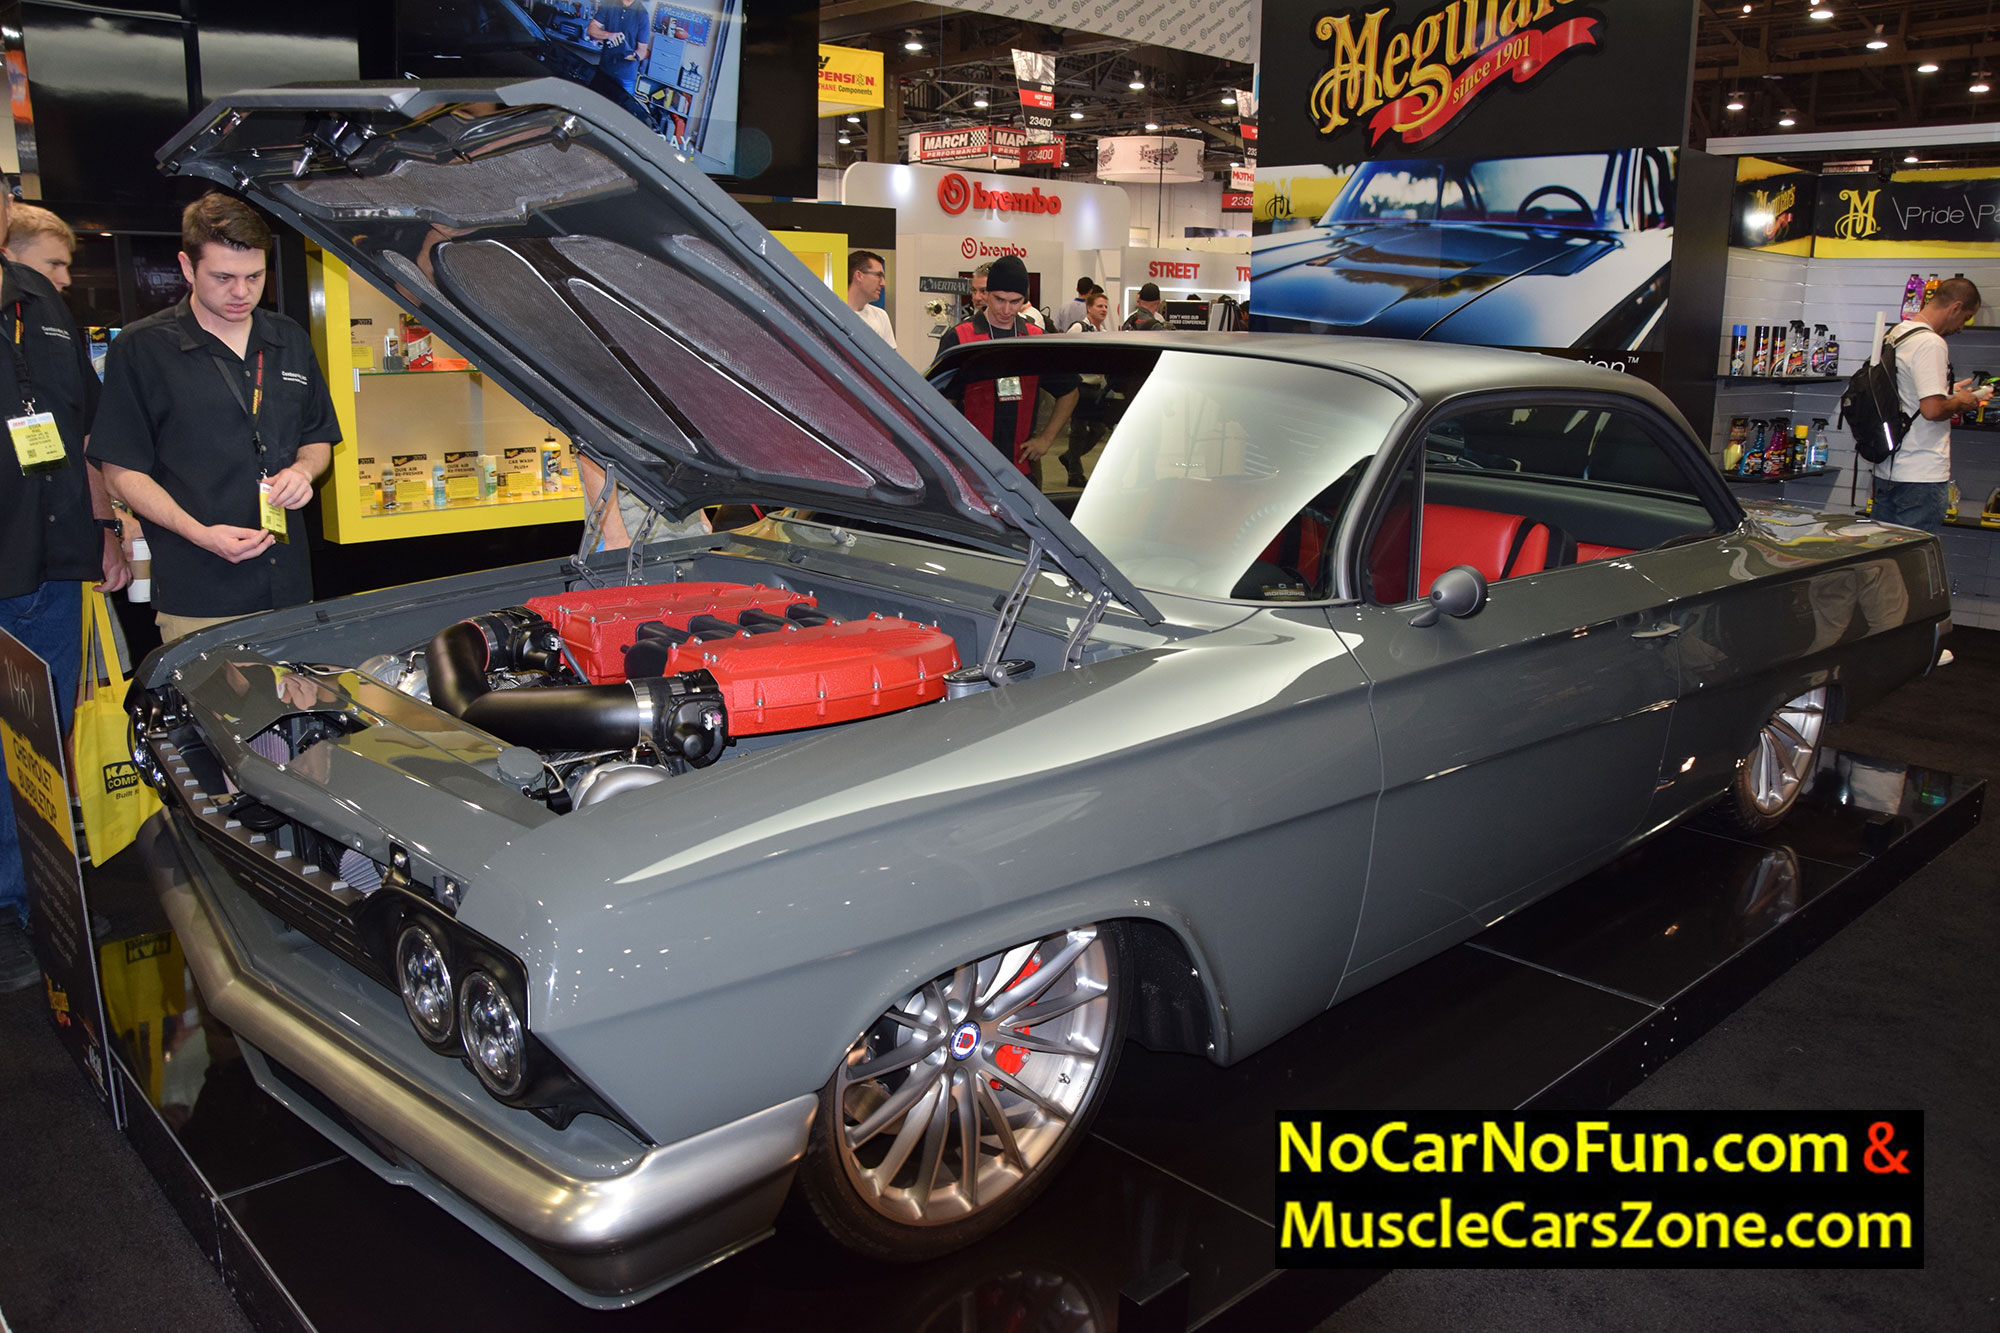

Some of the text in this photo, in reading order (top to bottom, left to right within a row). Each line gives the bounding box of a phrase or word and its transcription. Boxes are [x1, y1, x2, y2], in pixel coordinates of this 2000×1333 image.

[1452, 35, 1531, 104] since 1901
[838, 85, 873, 95] Components
[1029, 116, 1052, 127] 23400
[924, 133, 969, 151] MARCH
[926, 147, 982, 158] PERFORMANCE
[1027, 149, 1053, 161] 23400
[973, 181, 1062, 215] brembo
[980, 242, 1028, 258] brembo
[1148, 261, 1200, 279] STREET
[4, 656, 36, 722] 1962
[13, 736, 54, 797] CHEVROLET
[107, 774, 137, 790] COMP
[17, 766, 58, 826] BUBBLETOP
